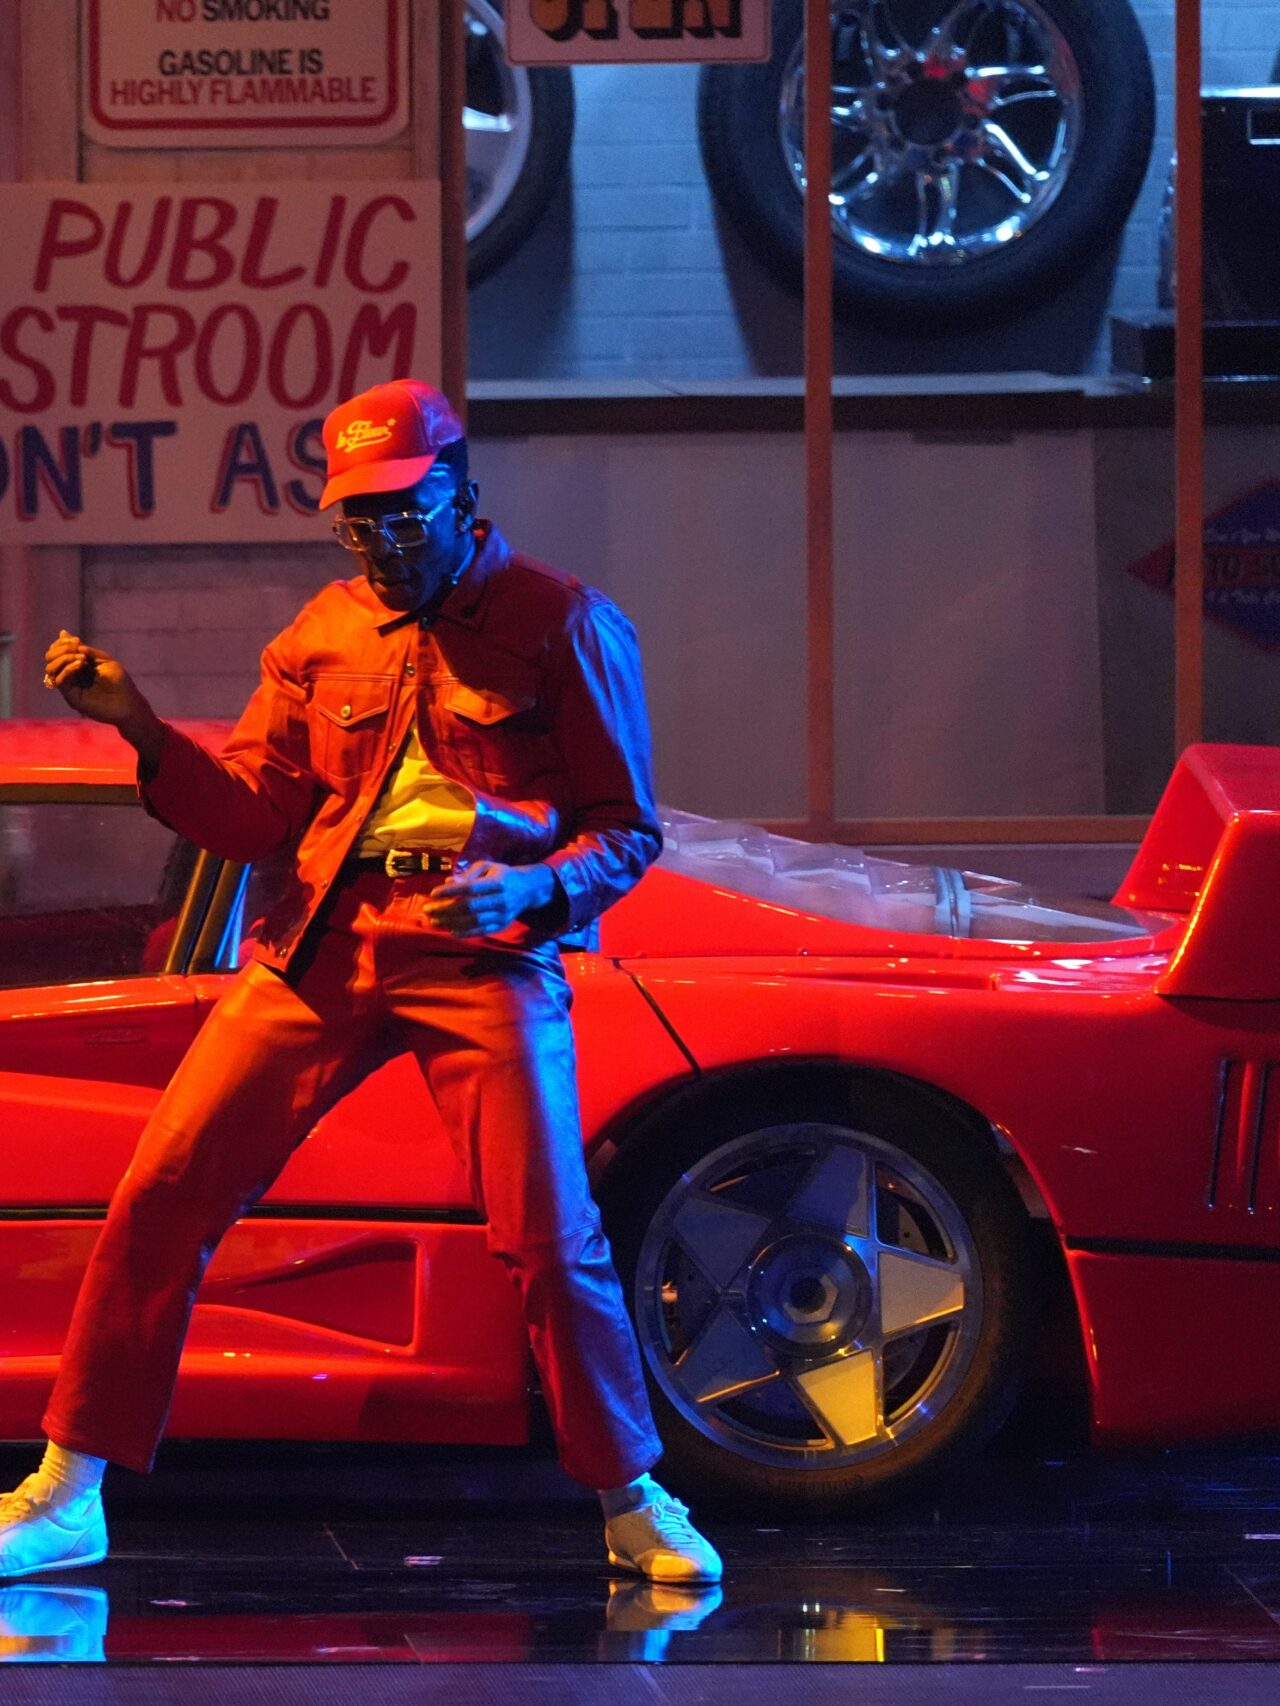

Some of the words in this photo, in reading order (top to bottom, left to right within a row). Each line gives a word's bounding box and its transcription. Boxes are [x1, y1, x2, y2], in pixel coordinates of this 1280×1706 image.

[156, 0, 198, 22] NO
[202, 0, 331, 22] SMOKING
[158, 49, 293, 76] GASOLINE
[299, 48, 325, 75] IS
[111, 79, 206, 106] HIGHLY
[208, 76, 378, 105] FLAMMABLE
[33, 194, 417, 294] PUBLIC
[210, 419, 329, 519] AS
